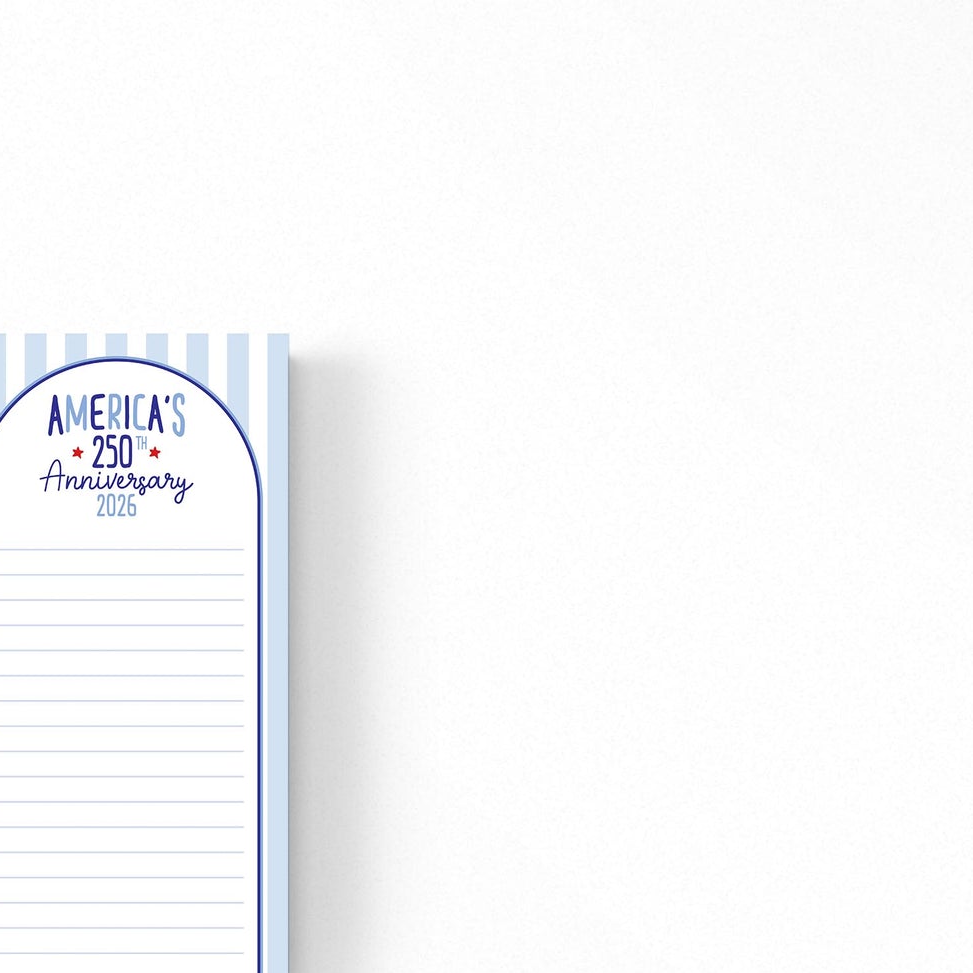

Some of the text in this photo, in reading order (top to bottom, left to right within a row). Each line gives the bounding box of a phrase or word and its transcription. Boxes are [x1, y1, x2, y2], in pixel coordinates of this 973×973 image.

[47, 393, 186, 437] AMERICA'S
[39, 458, 195, 504] Anniversary
[96, 493, 137, 517] 2026
